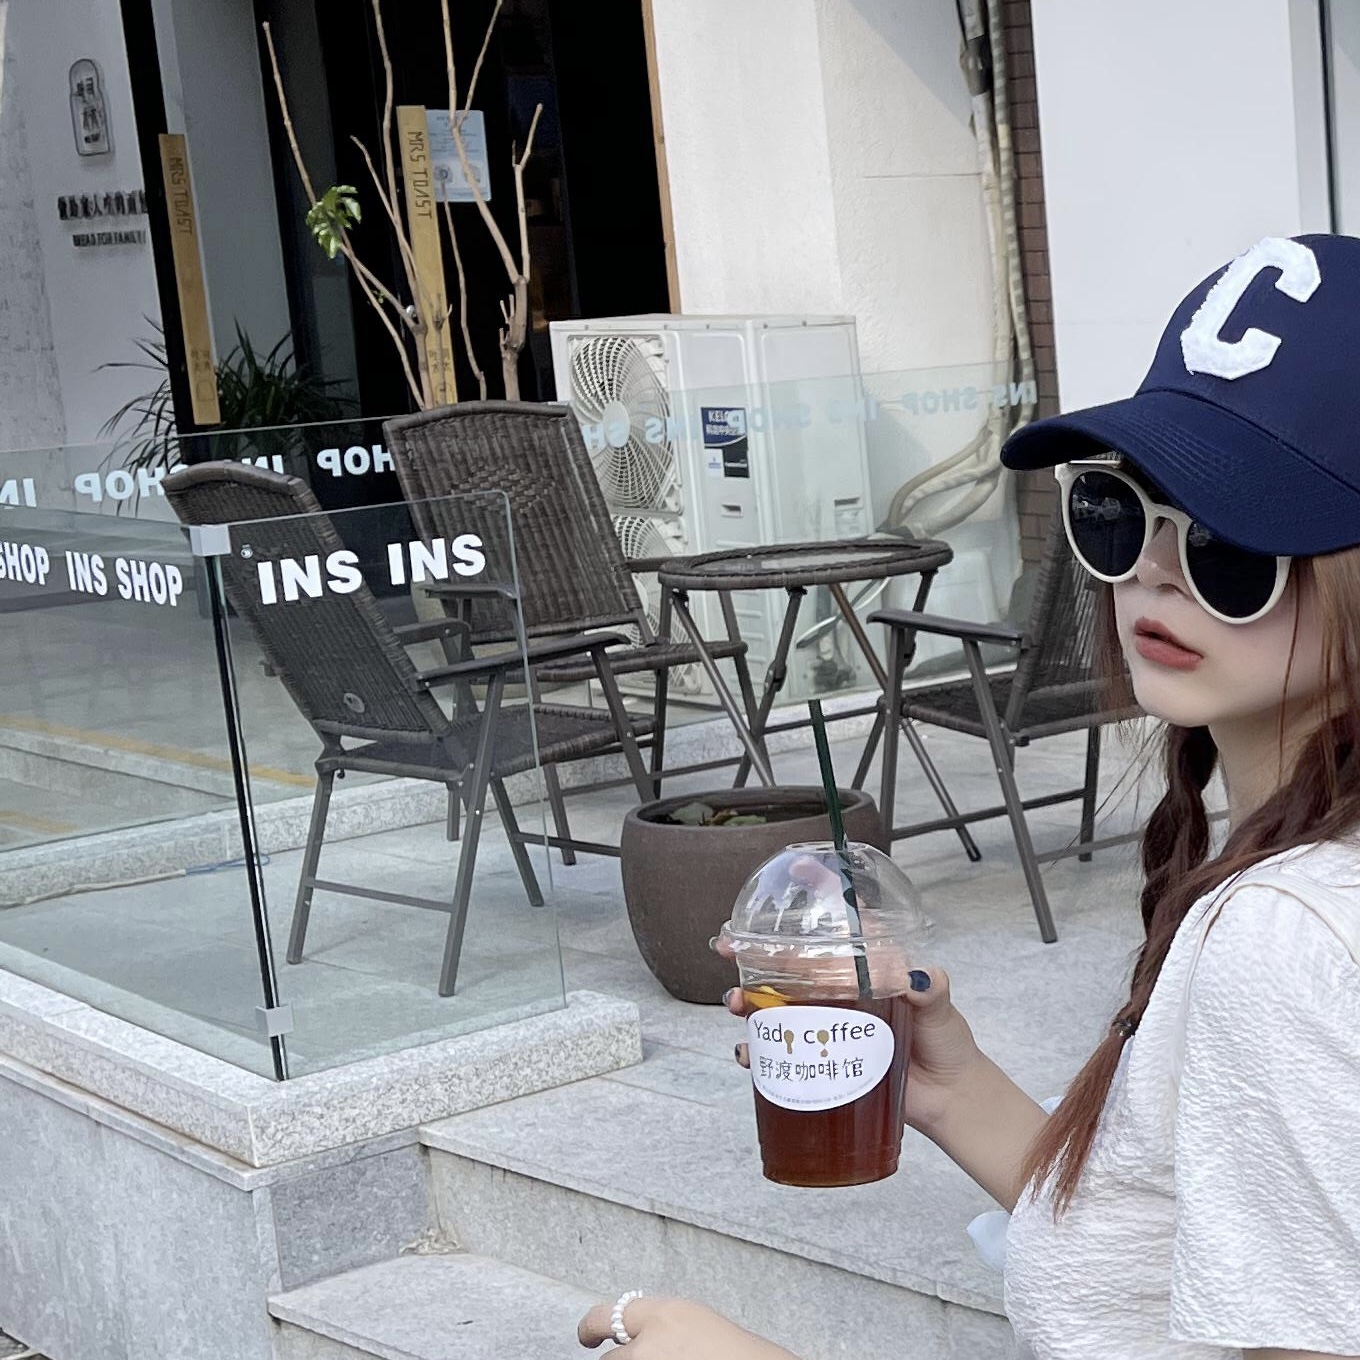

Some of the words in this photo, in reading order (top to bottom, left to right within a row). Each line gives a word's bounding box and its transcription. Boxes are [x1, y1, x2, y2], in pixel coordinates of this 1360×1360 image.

[406, 131, 426, 164] MRS
[411, 169, 433, 220] TOAST
[1180, 236, 1322, 381] C
[65, 550, 108, 596] INS
[115, 557, 184, 607] SHOP
[257, 550, 363, 605] INS
[387, 534, 486, 586] INS
[759, 1055, 864, 1083] 野渡咖啡馆
